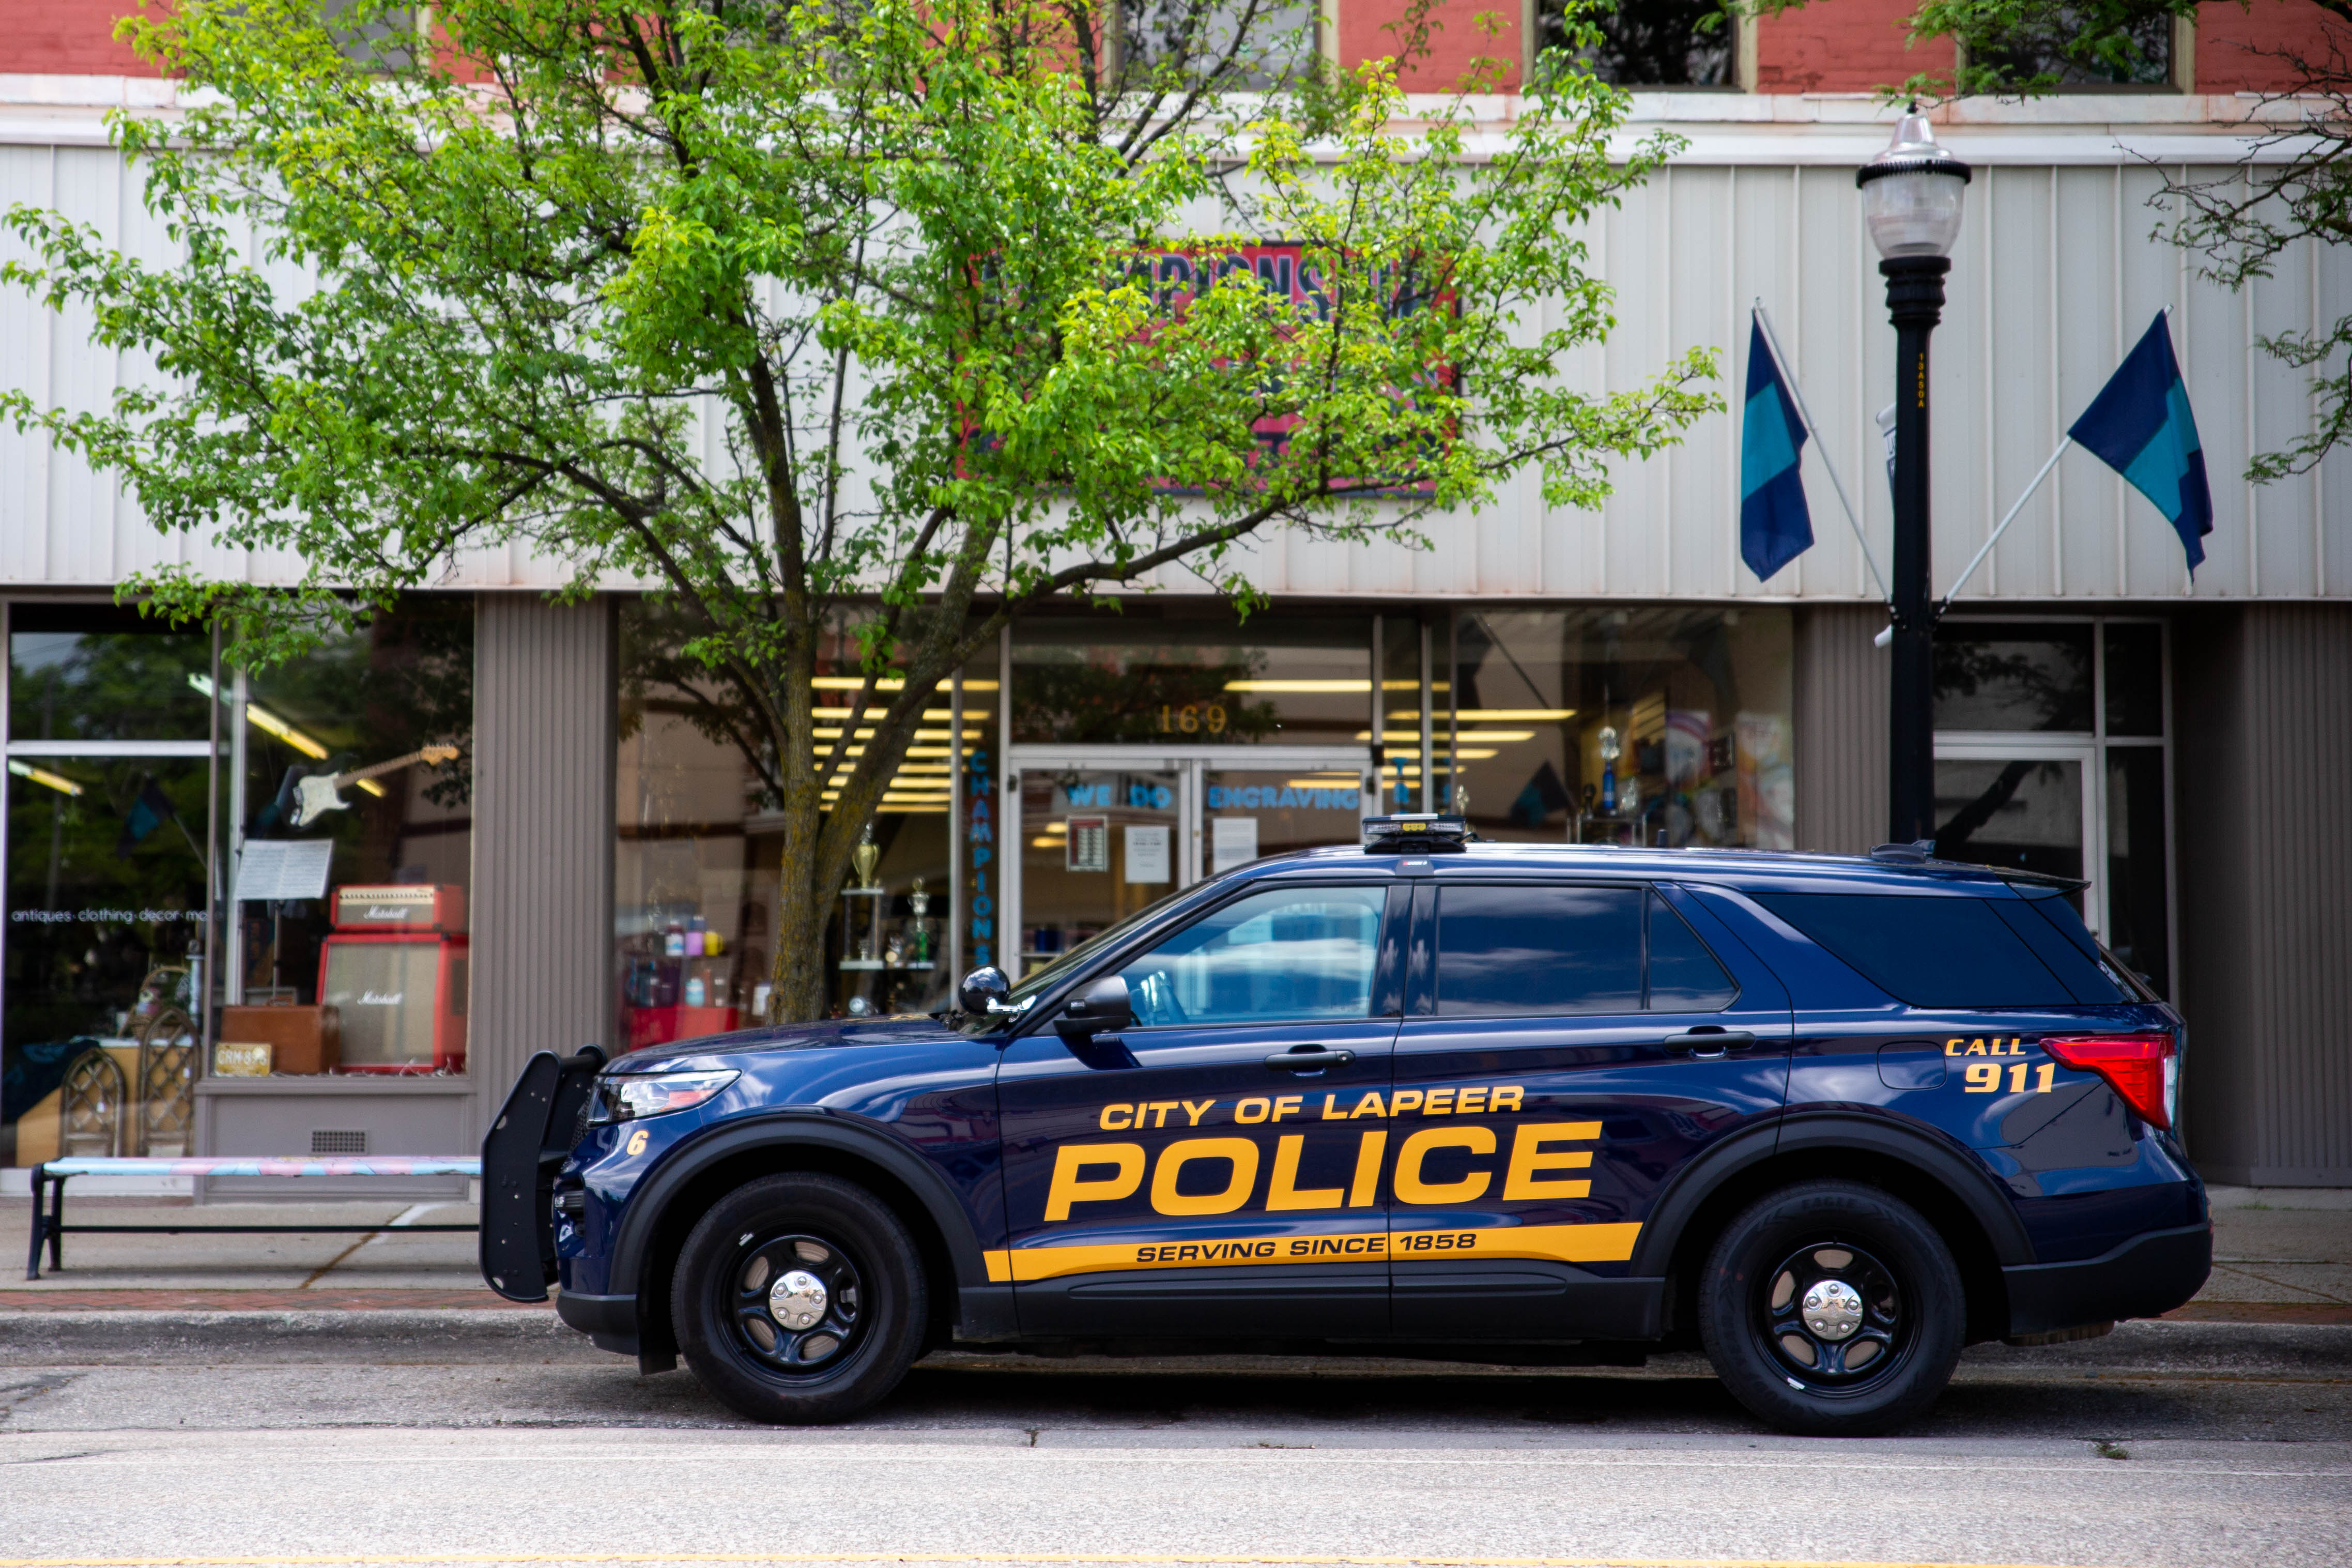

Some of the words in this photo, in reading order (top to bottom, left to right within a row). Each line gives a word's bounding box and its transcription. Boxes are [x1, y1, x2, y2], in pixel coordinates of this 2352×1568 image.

[1161, 704, 1227, 734] 169
[1066, 785, 1111, 807] WE
[1130, 784, 1172, 808] DO
[1208, 786, 1359, 810] ENGRAVING
[969, 751, 992, 965] CHAMPIONS
[11, 908, 72, 923] antiques
[78, 908, 134, 924] clothing
[139, 907, 180, 922] decor
[363, 904, 408, 919] Marshall
[357, 989, 402, 1005] Marshall
[1945, 1038, 2026, 1056] CALL
[1964, 1063, 2055, 1093] 911
[1099, 1099, 1216, 1130] CITY
[1234, 1096, 1303, 1124] OF
[1322, 1086, 1524, 1120] LAPEER
[627, 1130, 649, 1155] 6
[1044, 1121, 1603, 1221] POLICE
[1136, 1241, 1276, 1263] SERVING
[1289, 1237, 1386, 1256] SINCE
[1399, 1233, 1477, 1251] 1858
